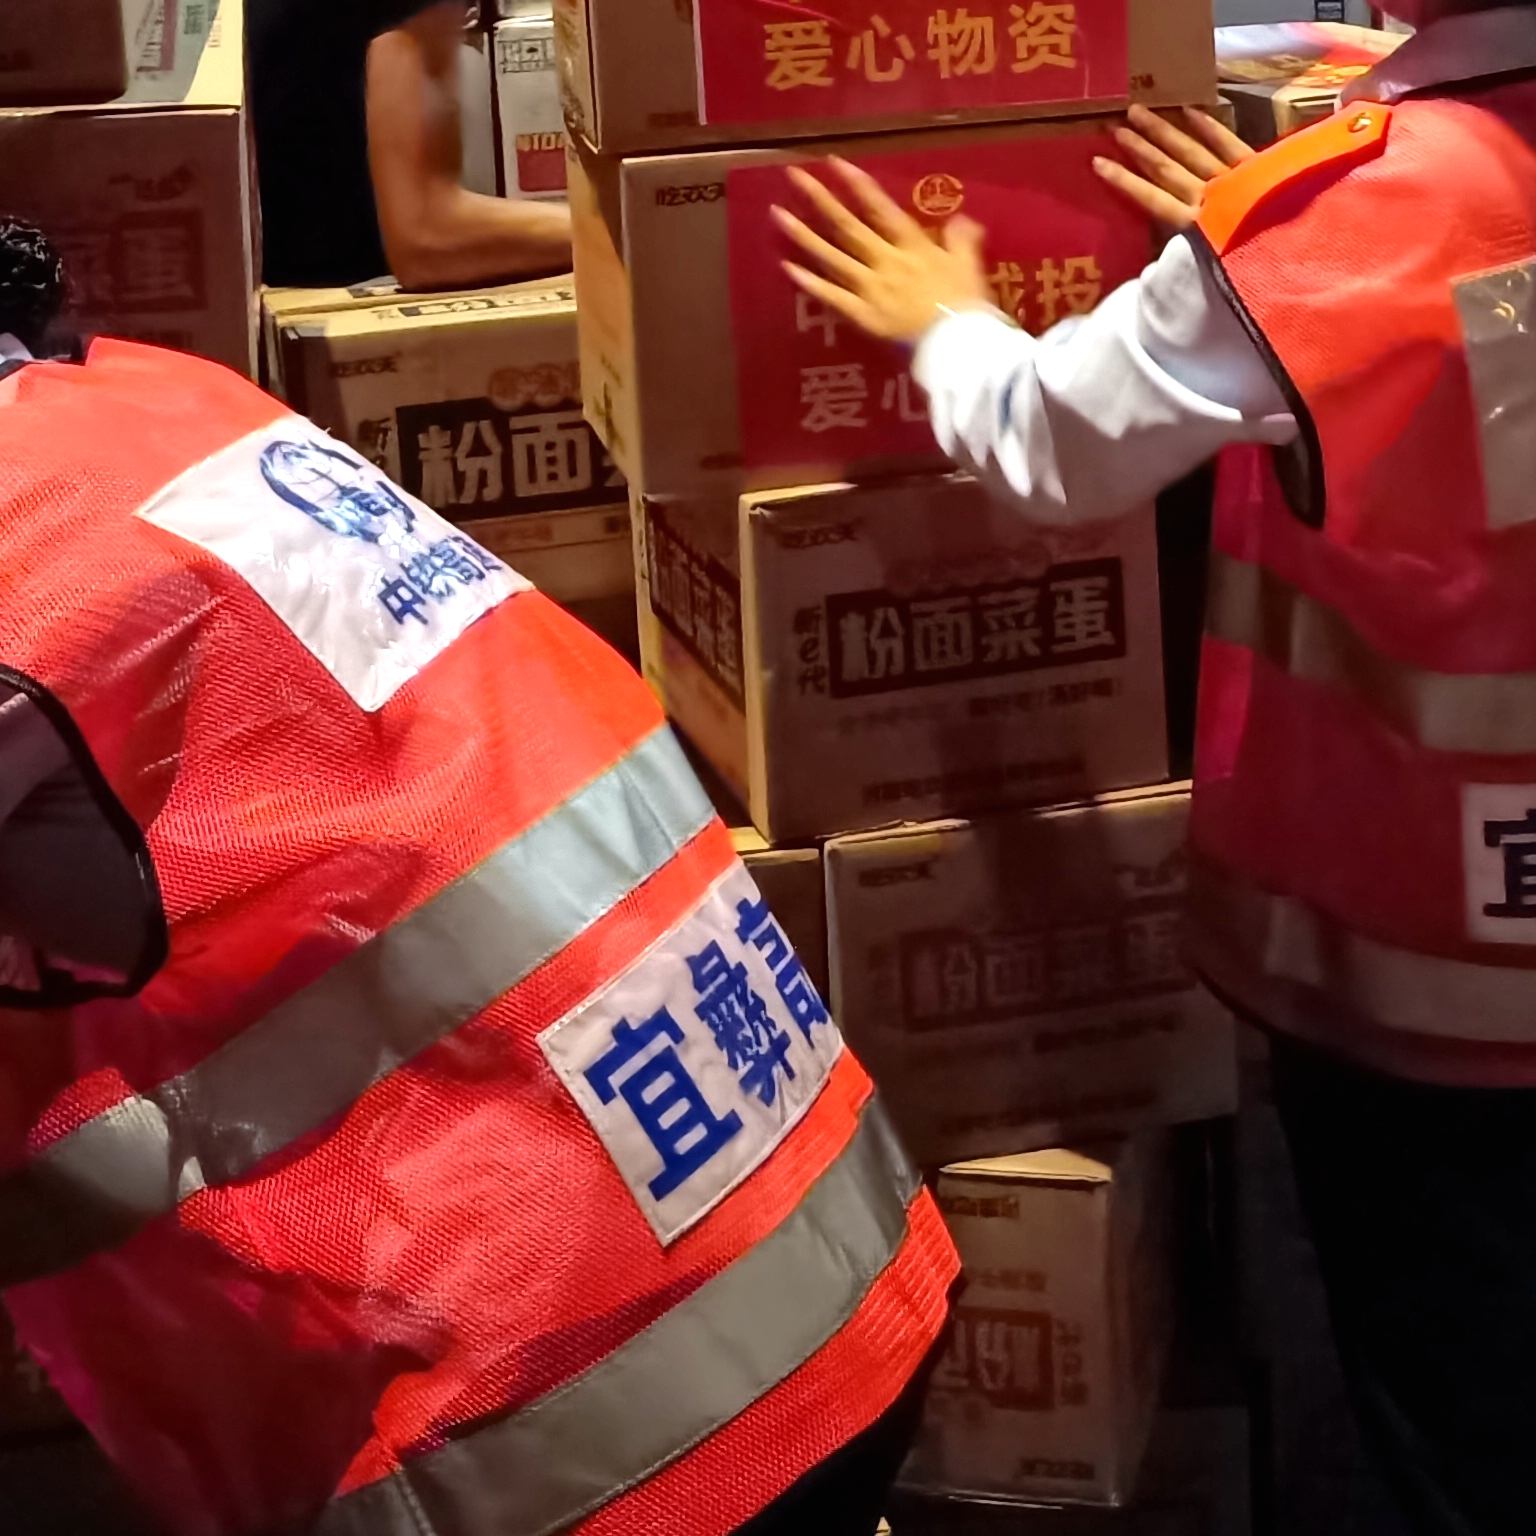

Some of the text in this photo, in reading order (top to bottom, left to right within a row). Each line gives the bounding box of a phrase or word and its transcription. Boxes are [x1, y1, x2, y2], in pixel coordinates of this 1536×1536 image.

[763, 1, 1078, 91] 爱心物资
[417, 409, 628, 510] 粉面
[838, 575, 1116, 683] 粉面菜蛋
